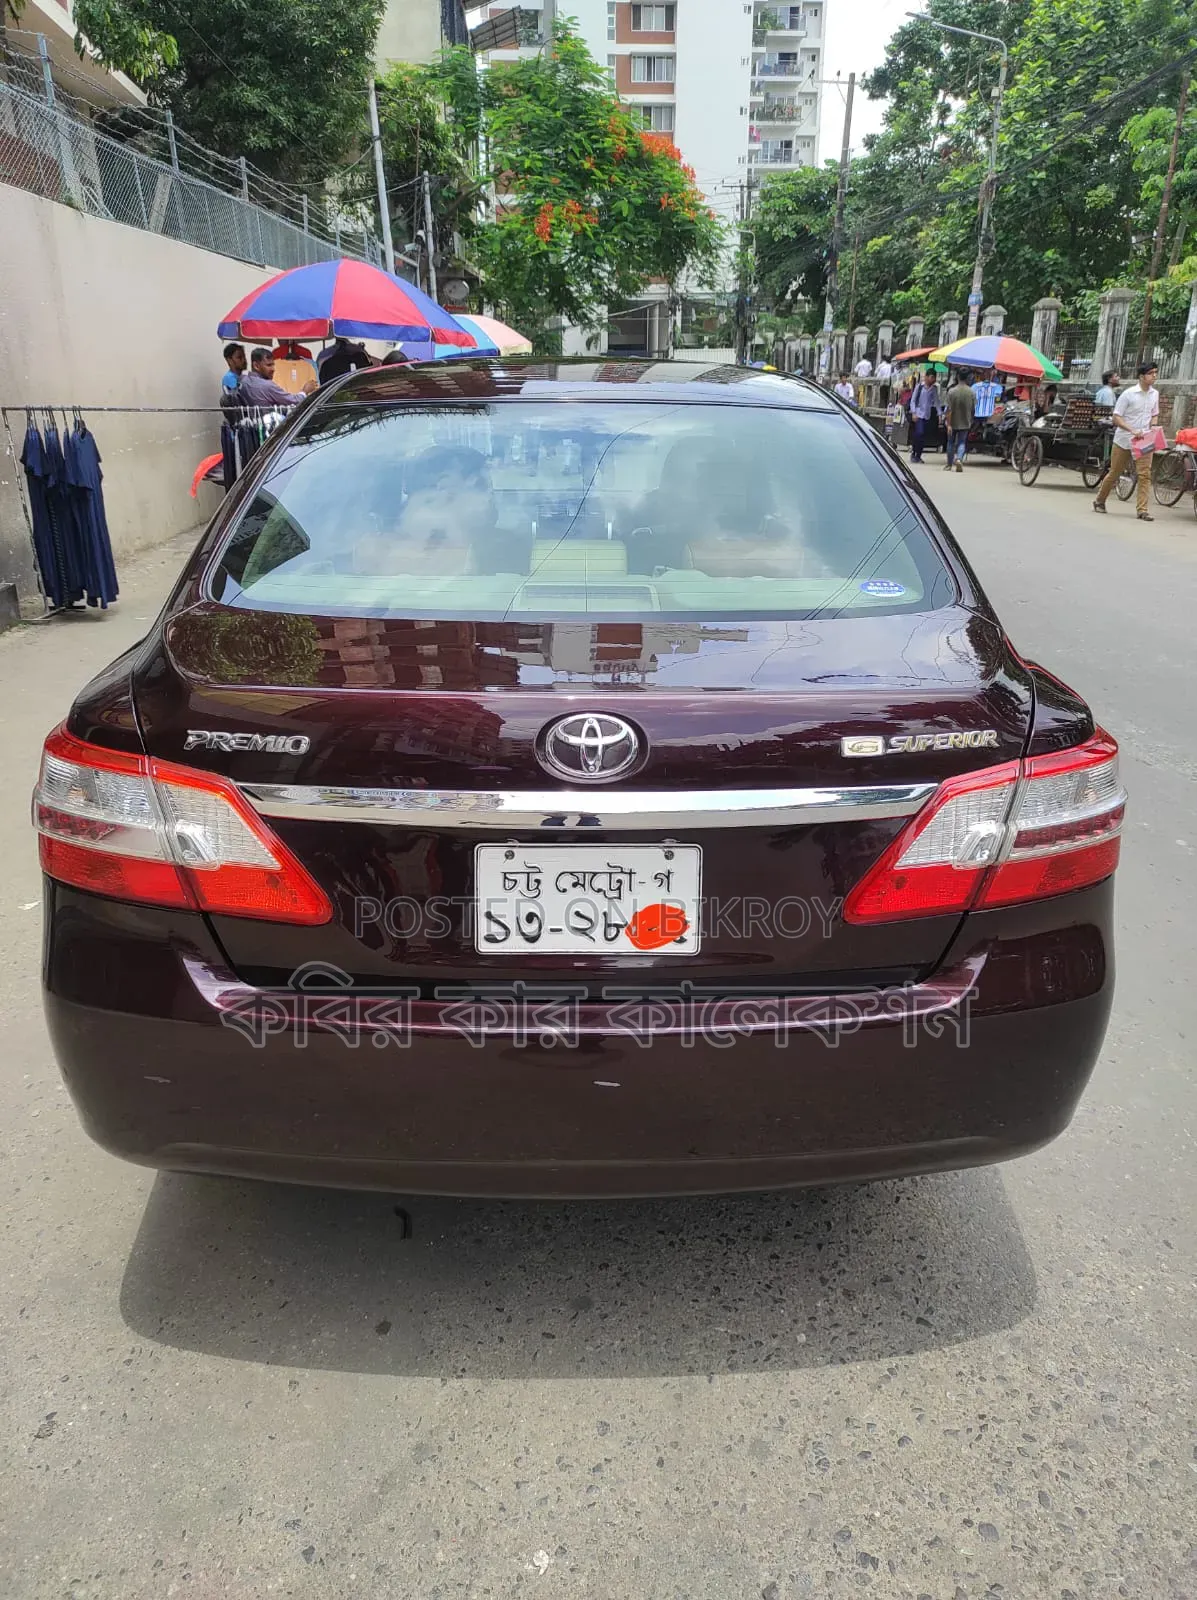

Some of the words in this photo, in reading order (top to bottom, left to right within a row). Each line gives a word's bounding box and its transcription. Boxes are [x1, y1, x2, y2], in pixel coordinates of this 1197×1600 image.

[183, 729, 311, 755] PREMIO
[886, 729, 1000, 753] SUPERIOR
[501, 861, 544, 899] চট্ট
[483, 909, 689, 944] ১৩-২৮
